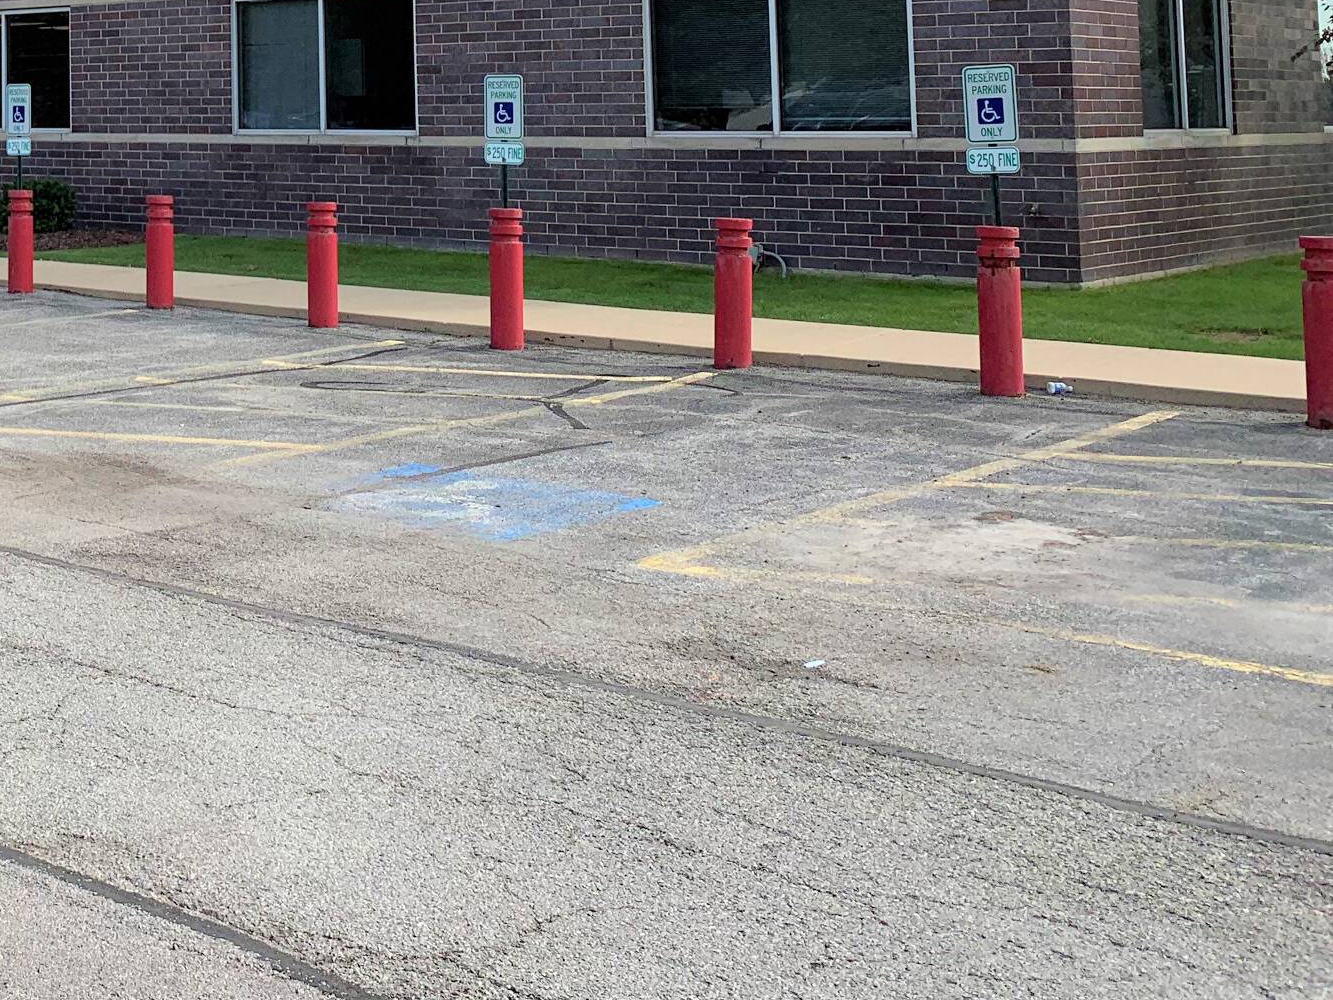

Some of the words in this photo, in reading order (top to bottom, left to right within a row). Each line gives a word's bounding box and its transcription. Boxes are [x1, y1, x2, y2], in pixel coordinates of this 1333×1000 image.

[967, 72, 1010, 83] RESERVED
[488, 81, 519, 89] RESERVED
[971, 85, 1007, 95] PARKING
[491, 91, 517, 99] PARKING
[496, 126, 512, 135] ONLY
[980, 127, 1003, 137] ONLY
[508, 147, 523, 160] FINE
[998, 152, 1017, 167] FINE
